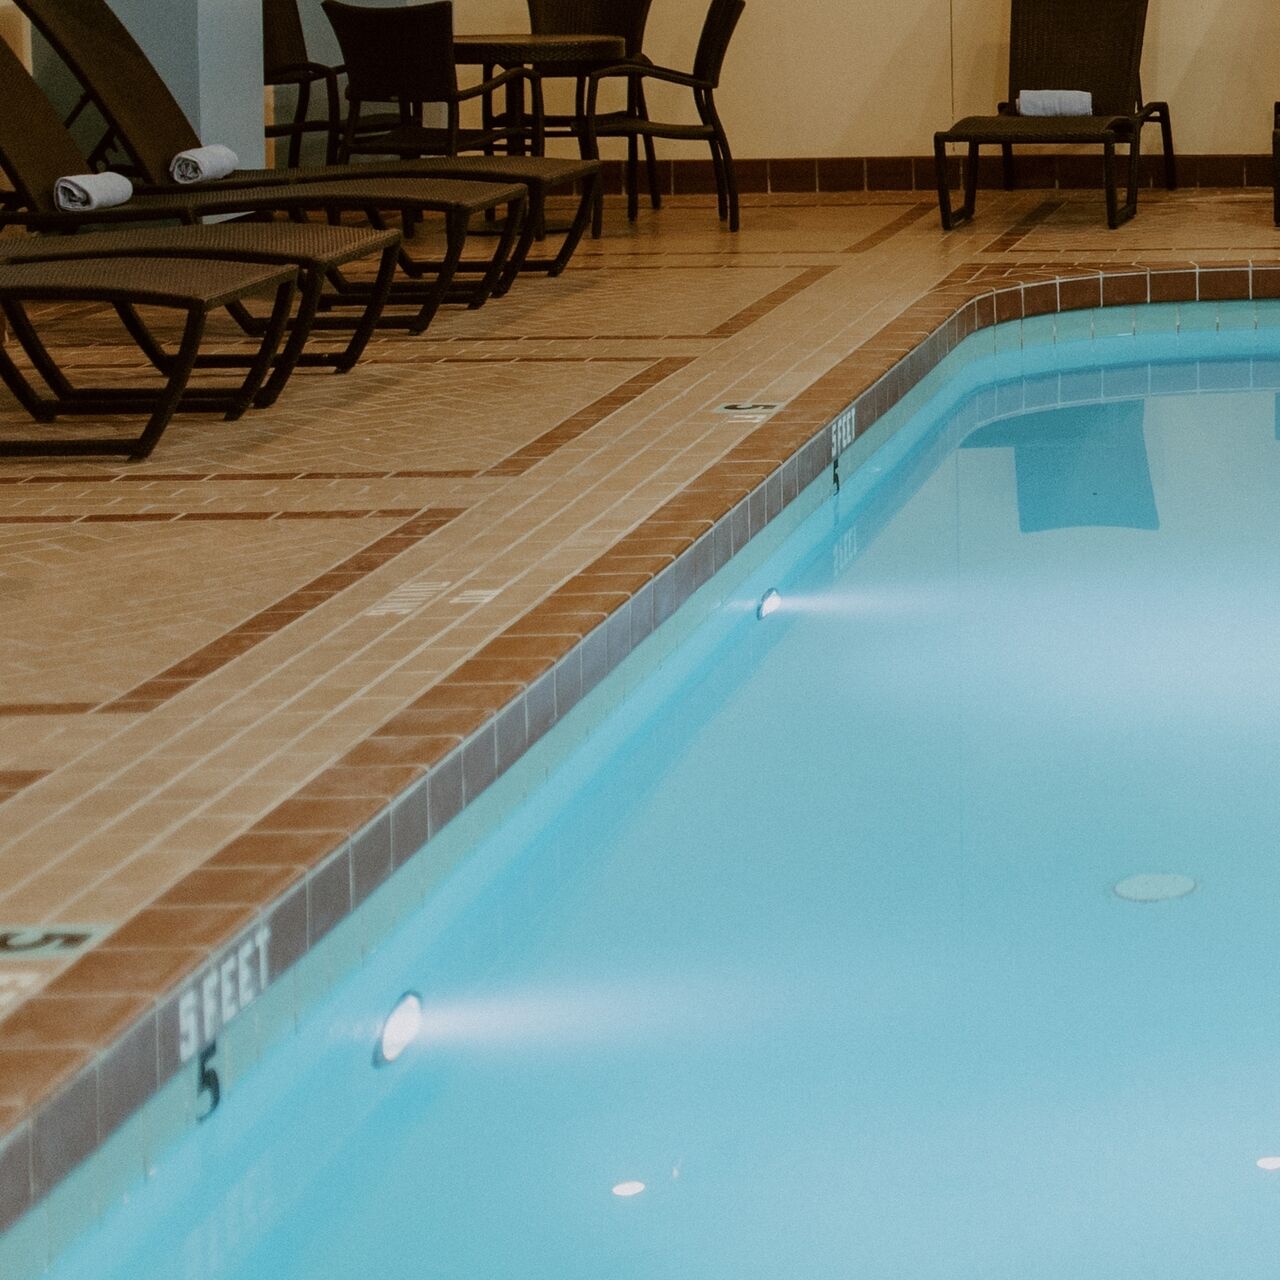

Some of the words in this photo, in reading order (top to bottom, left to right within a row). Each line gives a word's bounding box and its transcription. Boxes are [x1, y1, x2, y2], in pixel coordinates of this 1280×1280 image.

[837, 406, 856, 457] FEET
[202, 924, 271, 1043] FEET
[196, 1038, 220, 1124] 5
